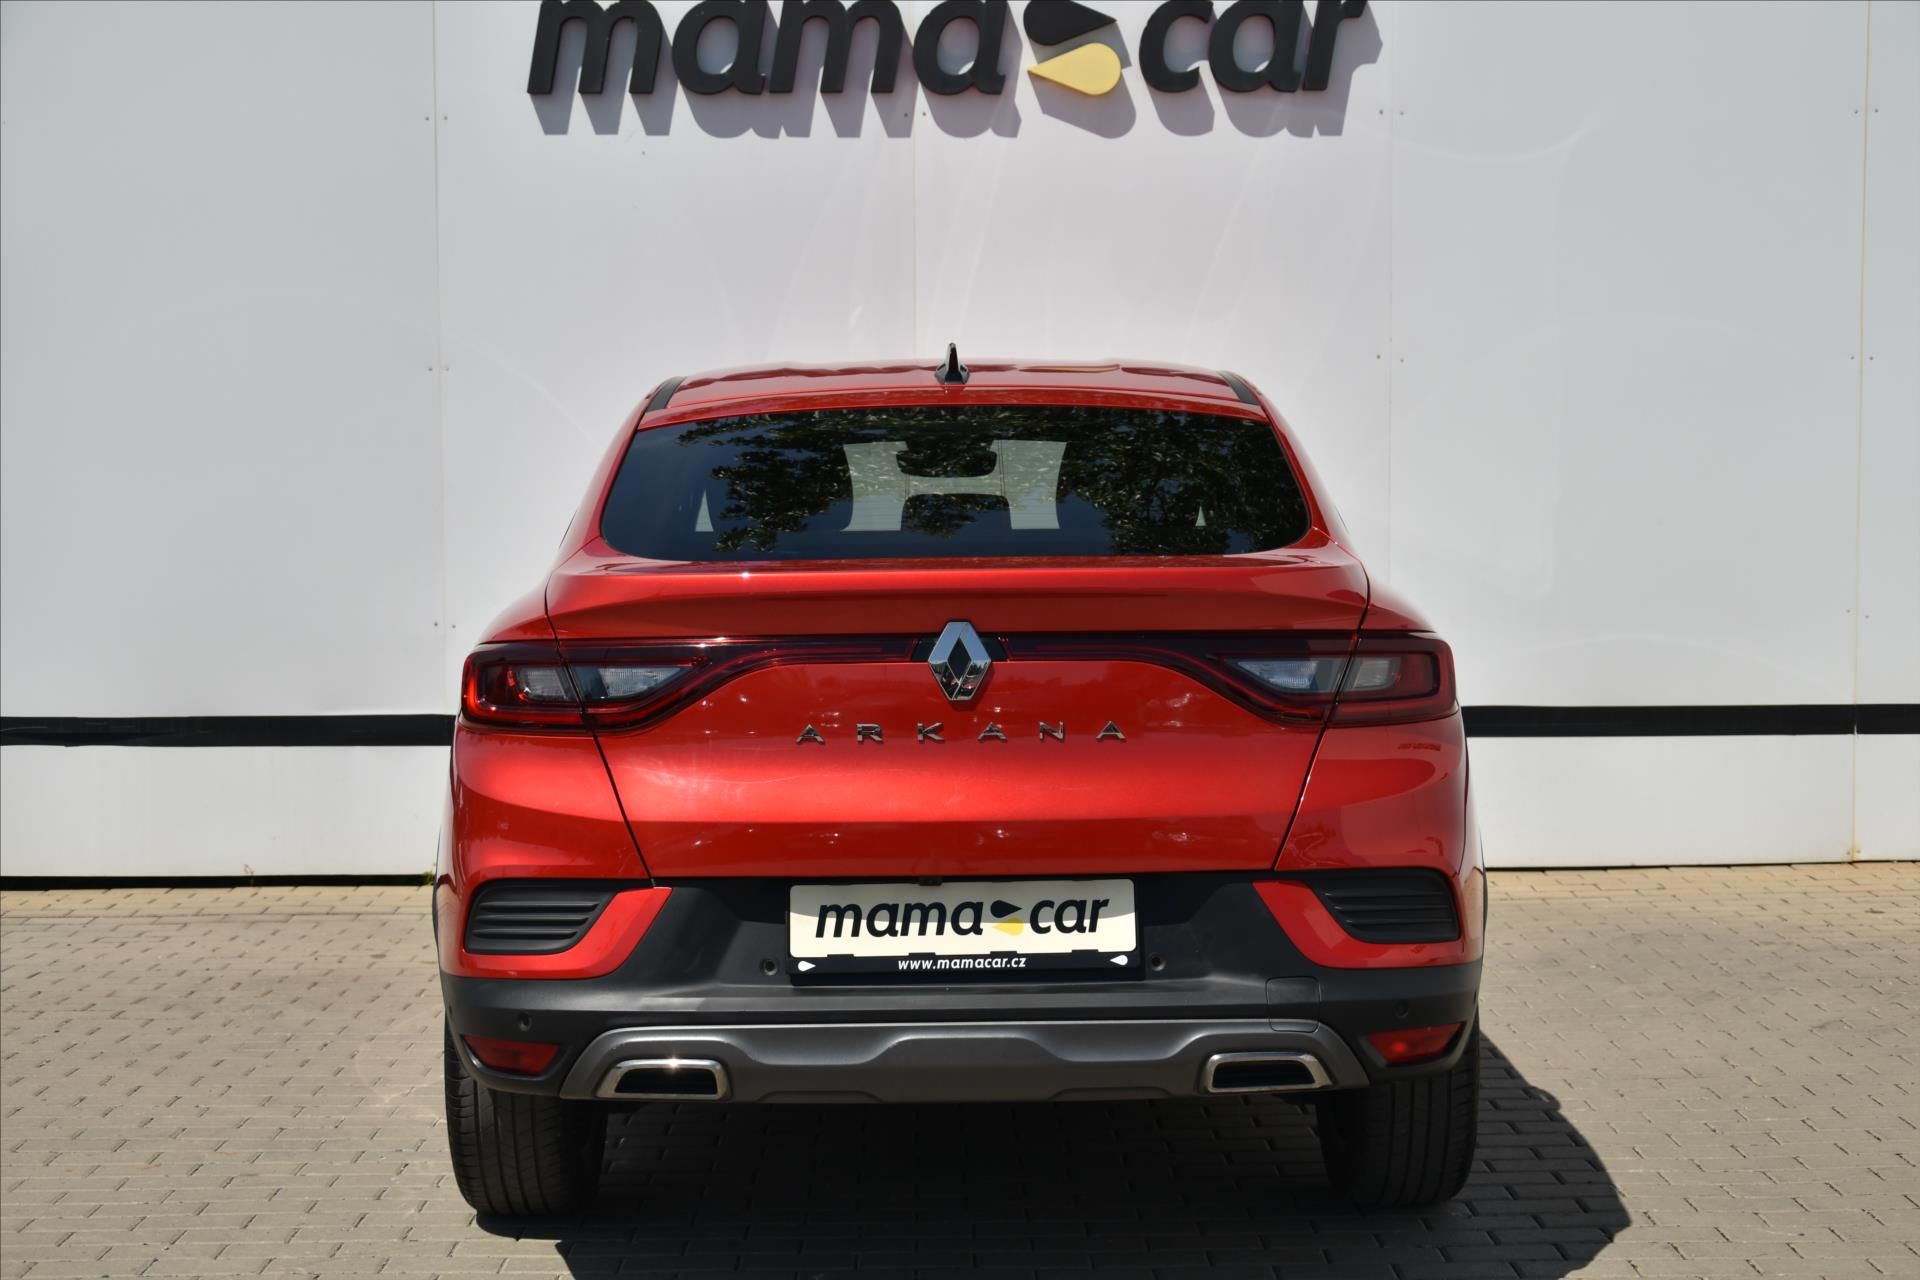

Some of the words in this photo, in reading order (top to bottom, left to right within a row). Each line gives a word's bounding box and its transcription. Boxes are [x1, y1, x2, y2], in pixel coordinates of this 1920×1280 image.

[527, 0, 1005, 95] mama
[1138, 0, 1366, 93] car
[796, 721, 1126, 743] ARKANA
[815, 901, 984, 938] mama
[1029, 898, 1109, 934] car
[898, 956, 1026, 970] www.mamacar.cz
